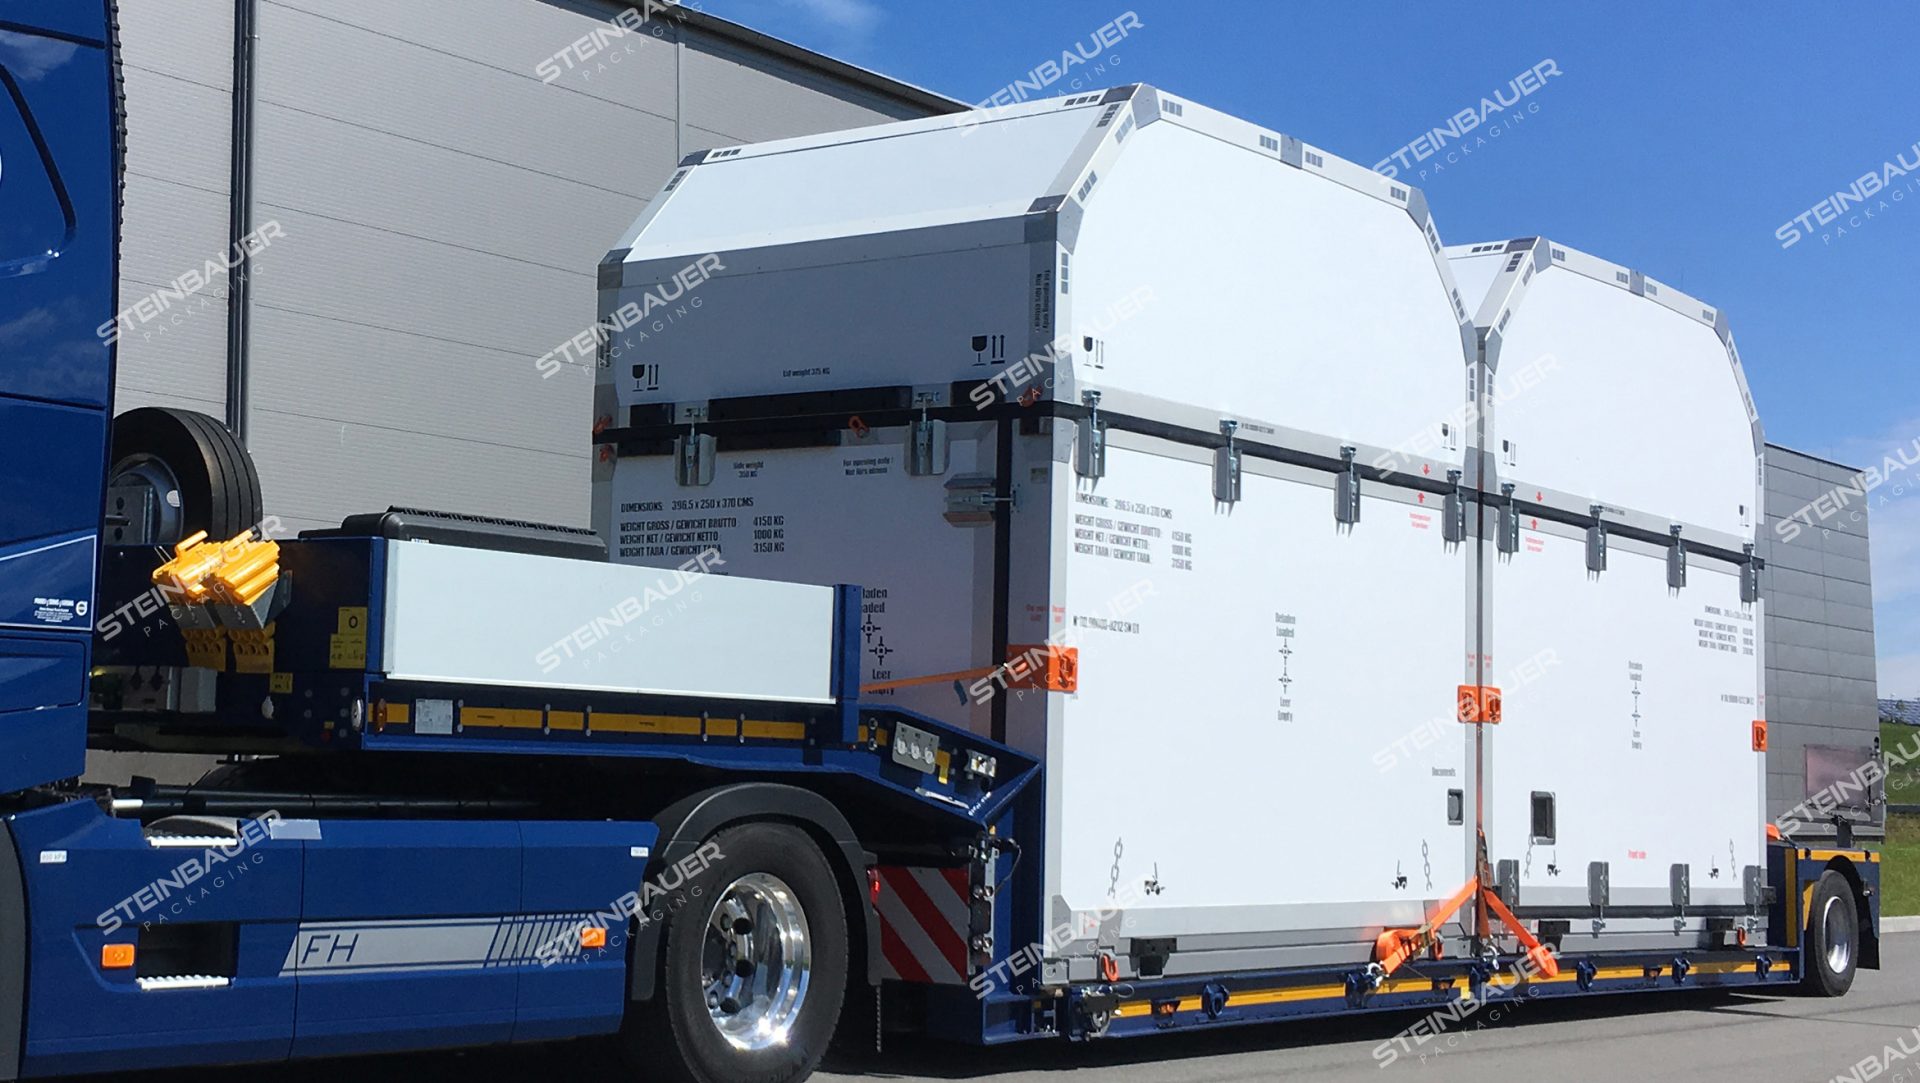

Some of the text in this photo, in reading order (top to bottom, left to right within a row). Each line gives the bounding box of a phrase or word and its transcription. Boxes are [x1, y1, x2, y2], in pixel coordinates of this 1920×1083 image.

[671, 499, 693, 511] 396.5
[700, 498, 716, 509] 250
[721, 497, 736, 508] 370
[620, 520, 645, 532] WEIGHT
[646, 519, 670, 531] GROSS
[675, 518, 707, 530] GEWICHT
[753, 515, 772, 527] 4150
[773, 515, 784, 526] KG
[1075, 513, 1094, 526] WEIGHT
[1117, 520, 1139, 534] GEWICHT
[619, 533, 645, 545] WEIGHT
[646, 533, 659, 544] NET
[665, 532, 695, 543] GEWICHT
[753, 529, 772, 540] 1000
[773, 528, 784, 539] KG
[1074, 528, 1094, 540] WEIGHT
[1095, 531, 1105, 542] NET
[1109, 533, 1131, 546] GEWICHT
[619, 546, 645, 558] WEIGHT
[646, 545, 664, 557] TARA
[670, 544, 701, 555] GEWICHT
[753, 542, 772, 553] 3150
[773, 542, 785, 553] KG
[1074, 542, 1094, 555] WEIGHT
[1113, 548, 1136, 561] GEWICHT
[872, 669, 891, 680] Leer
[302, 933, 359, 965] FH
